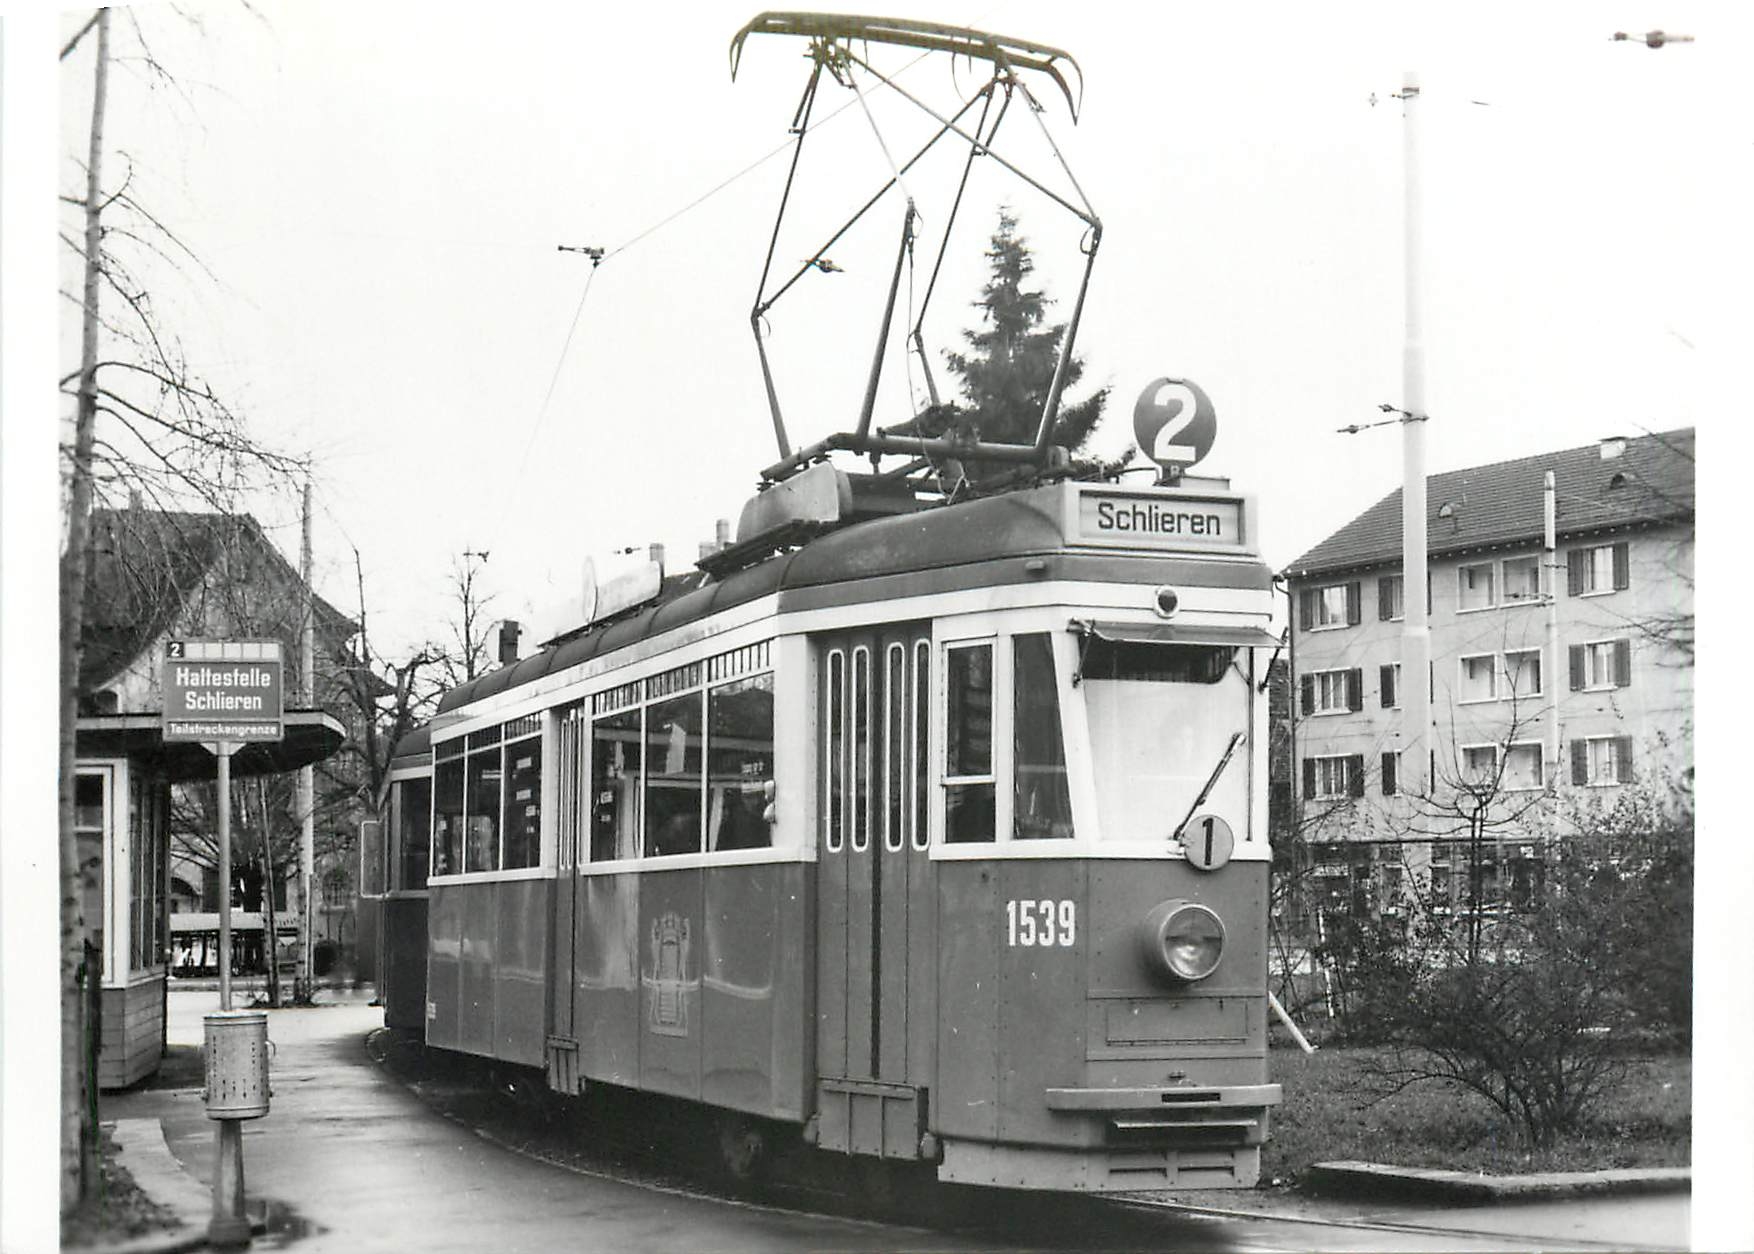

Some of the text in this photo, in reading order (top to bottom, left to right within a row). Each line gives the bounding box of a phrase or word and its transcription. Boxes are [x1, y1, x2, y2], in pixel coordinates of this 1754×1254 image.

[1154, 384, 1196, 462] 2
[1098, 502, 1221, 536] Schlieren
[171, 643, 180, 657] 2
[176, 667, 271, 687] Haltestelle
[185, 691, 262, 710] Schlieren
[170, 723, 277, 737] Teilstreckengrenze
[1202, 817, 1214, 866] 1
[1006, 900, 1075, 946] 1539
